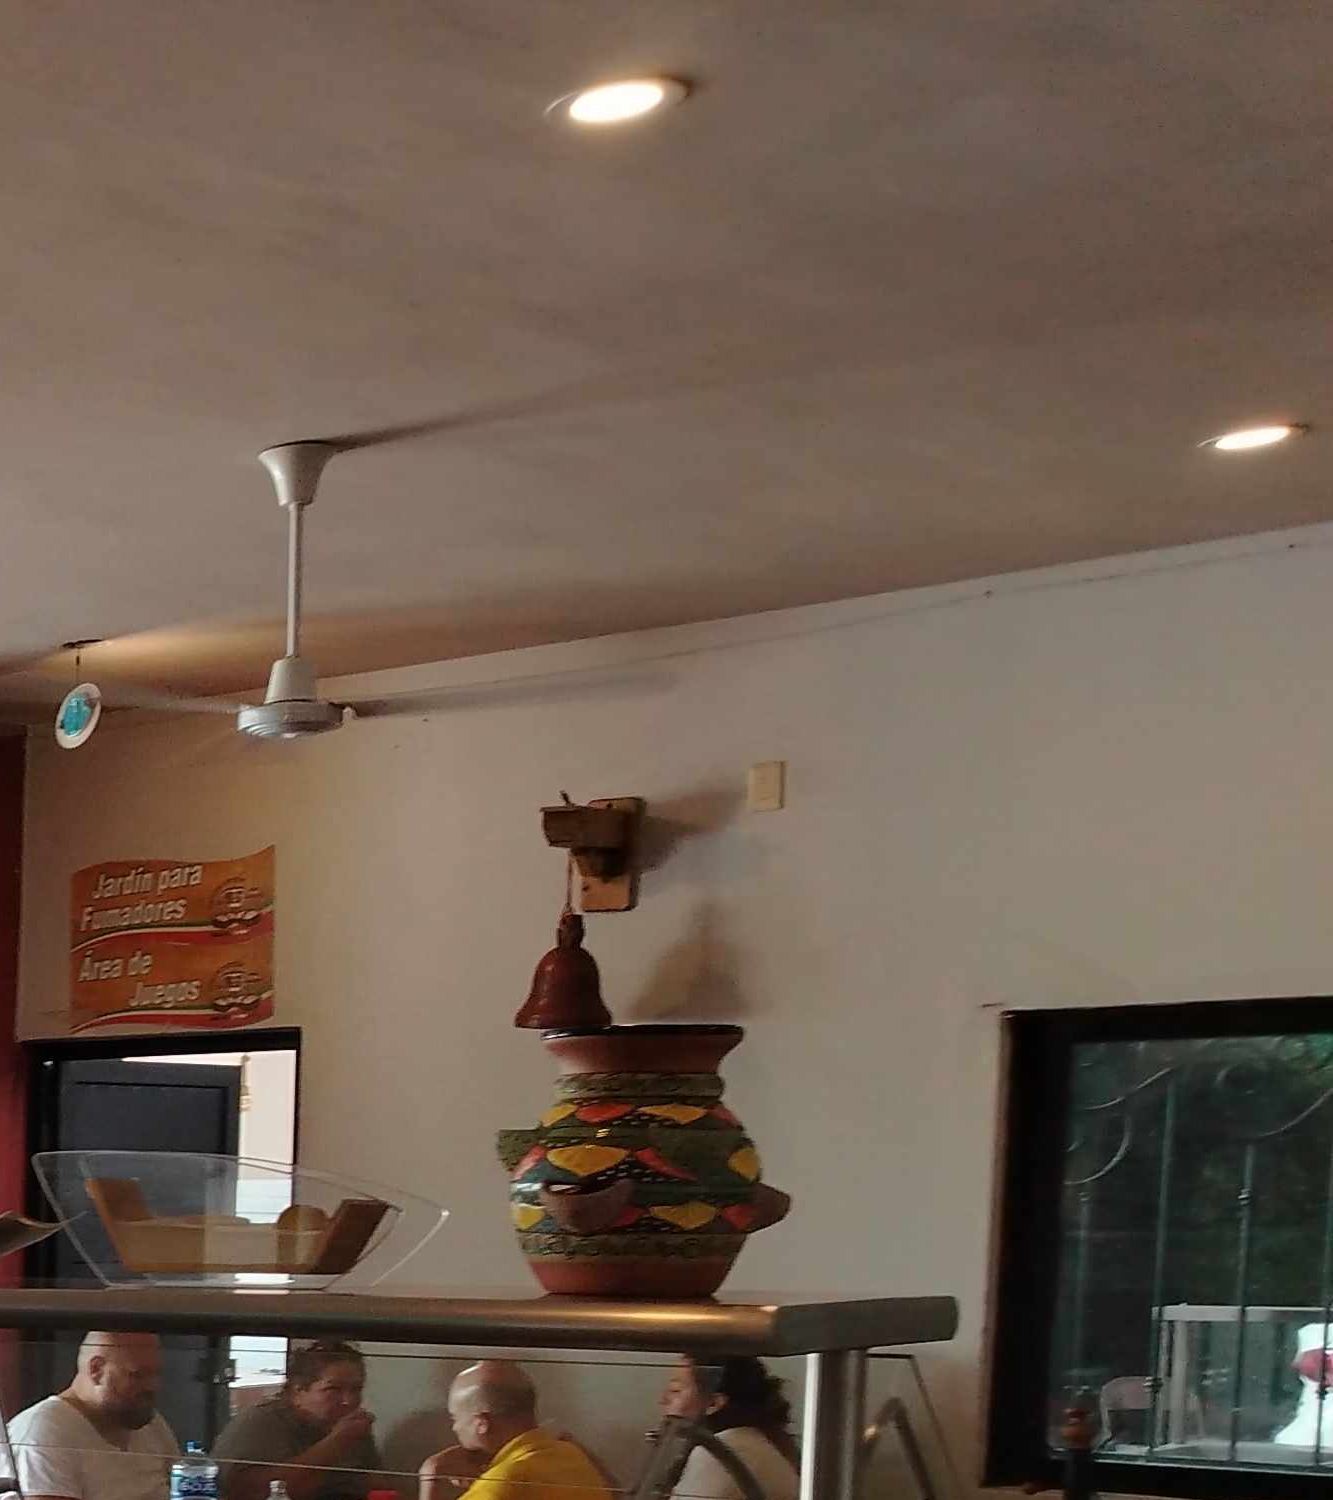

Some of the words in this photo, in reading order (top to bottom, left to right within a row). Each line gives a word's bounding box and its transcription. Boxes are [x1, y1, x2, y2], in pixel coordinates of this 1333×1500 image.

[93, 867, 153, 899] Jardín
[157, 864, 202, 896] para
[80, 899, 187, 931] Fumadores
[77, 949, 123, 983] Área
[128, 950, 152, 977] de
[129, 980, 201, 1008] Juegos
